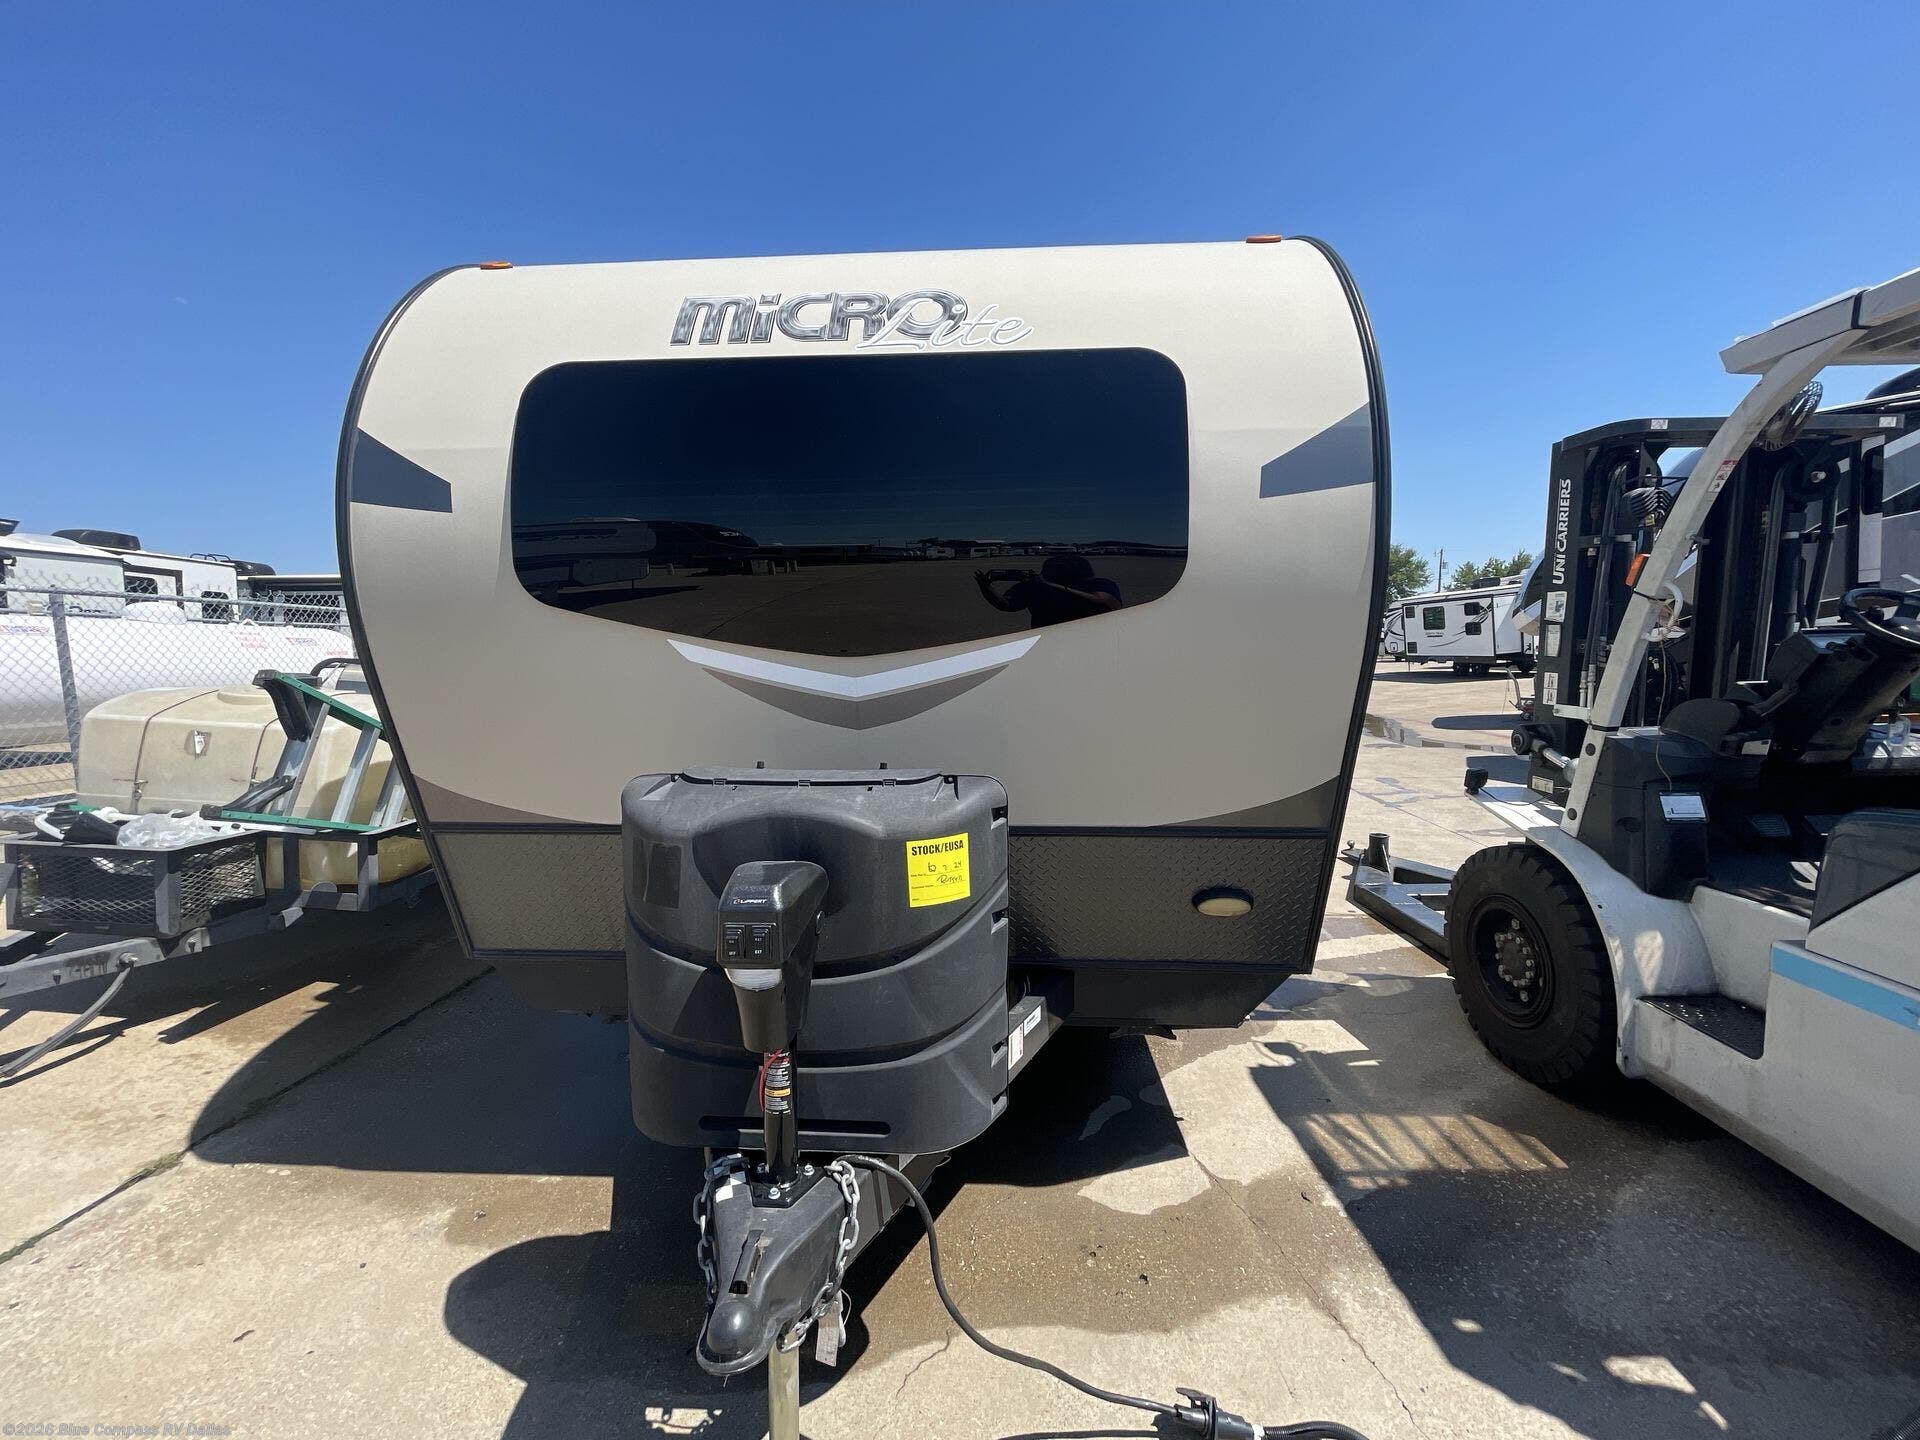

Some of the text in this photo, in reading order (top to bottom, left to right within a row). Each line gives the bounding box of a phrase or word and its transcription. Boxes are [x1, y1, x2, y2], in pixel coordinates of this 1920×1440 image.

[855, 297, 1034, 351] Lite
[1552, 478, 1571, 585] UNICARRIERS
[911, 839, 964, 856] STOCK/EUSA
